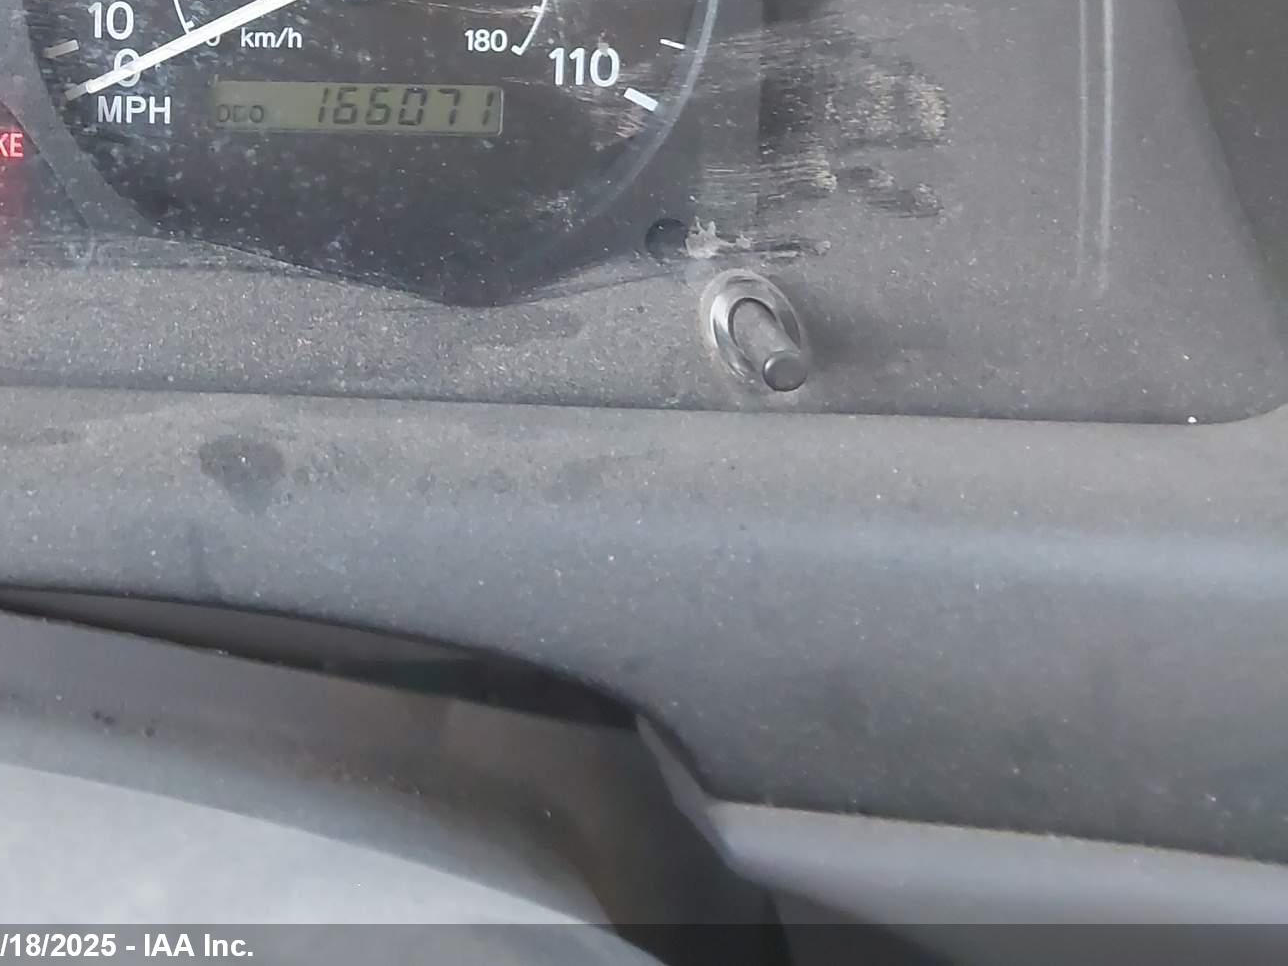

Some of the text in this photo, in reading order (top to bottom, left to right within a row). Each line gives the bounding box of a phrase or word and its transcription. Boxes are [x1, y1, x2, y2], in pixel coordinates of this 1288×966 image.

[87, 0, 134, 40] 10
[240, 26, 303, 49] km/h
[464, 28, 508, 52] 180
[112, 47, 142, 88] 0
[548, 45, 620, 88] 110
[98, 95, 171, 124] MPH
[317, 86, 495, 127] 166071
